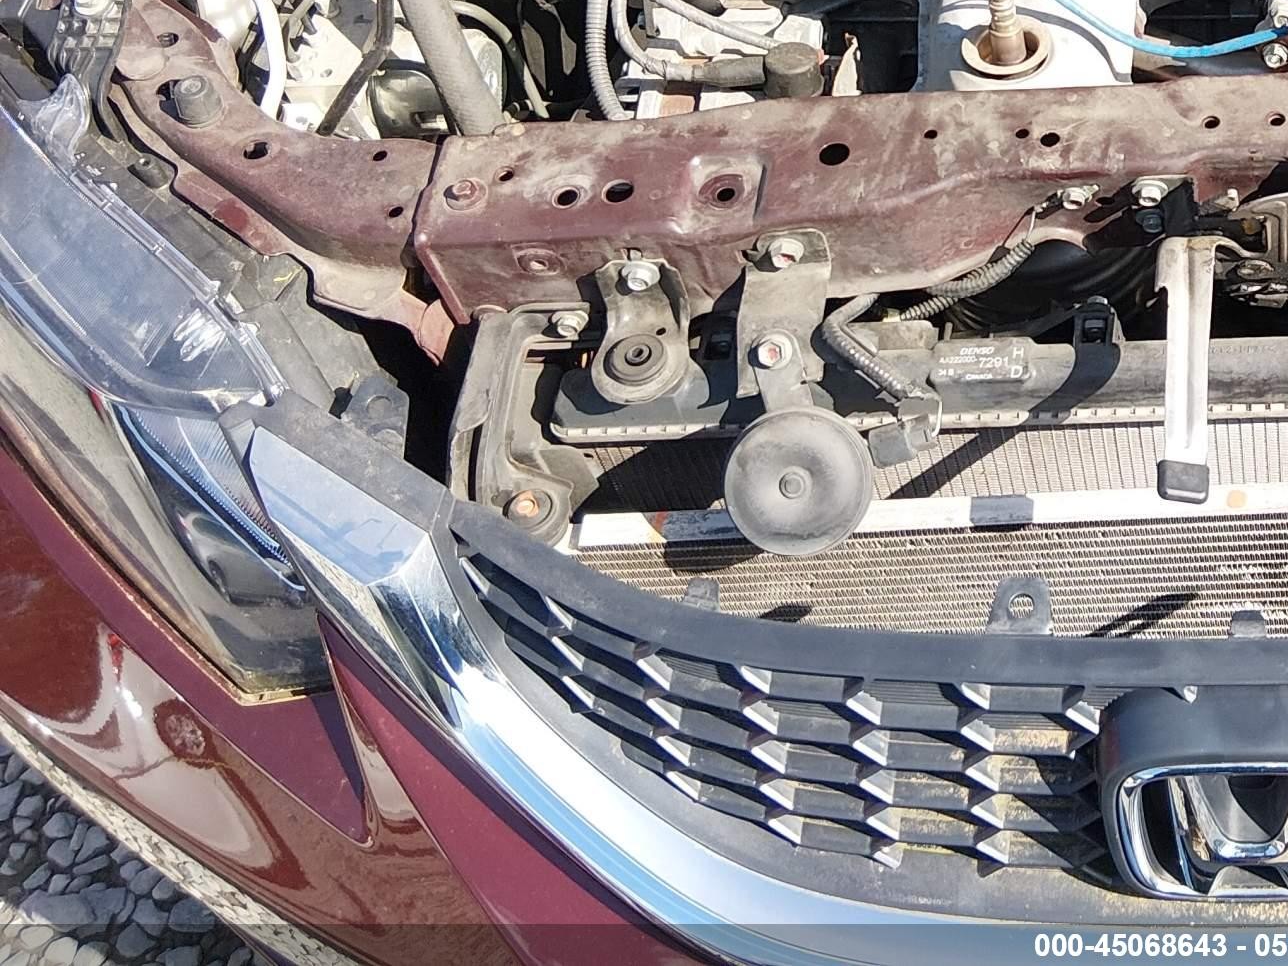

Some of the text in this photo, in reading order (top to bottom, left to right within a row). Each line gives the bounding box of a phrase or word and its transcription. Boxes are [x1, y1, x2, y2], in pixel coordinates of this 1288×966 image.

[960, 346, 995, 355] DENSO
[1012, 347, 1024, 359] H
[1010, 366, 1023, 378] D
